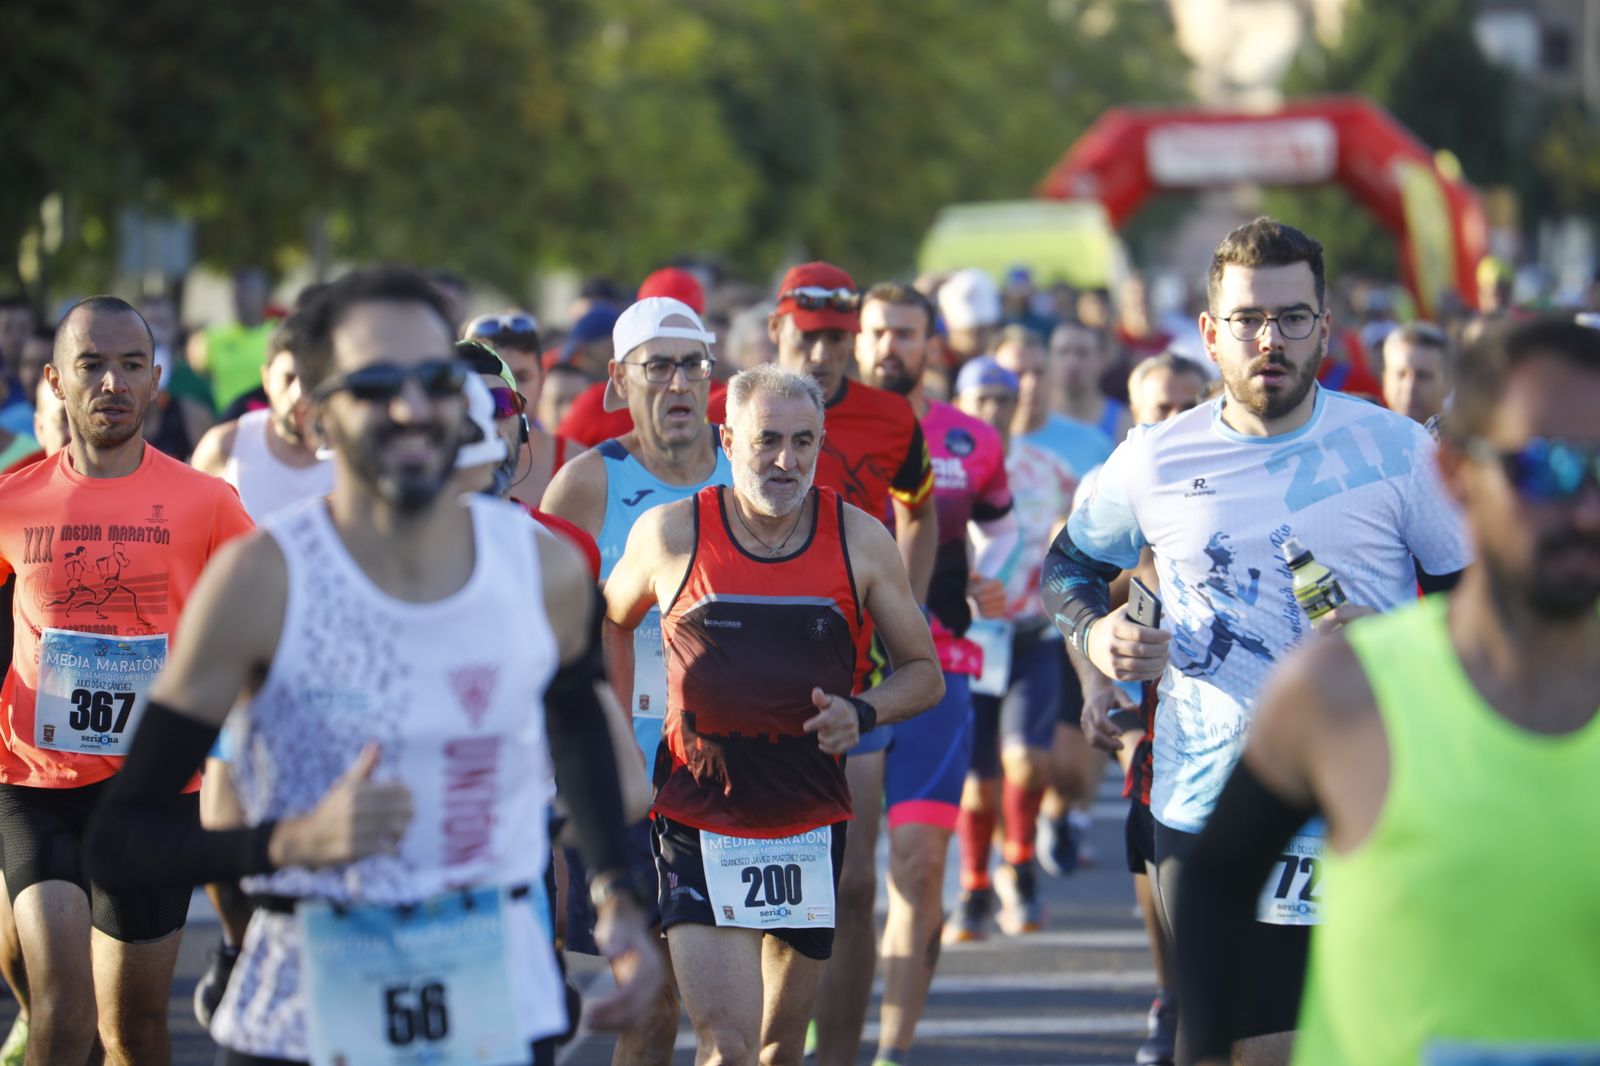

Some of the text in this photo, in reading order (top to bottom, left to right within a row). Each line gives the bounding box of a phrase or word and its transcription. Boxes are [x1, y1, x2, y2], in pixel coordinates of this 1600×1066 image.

[24, 524, 170, 564] XXX MEDIA MARATÓN
[46, 653, 163, 673] MEDIA MARATÓN
[69, 688, 136, 733] 367
[709, 837, 756, 849] MEDIA
[751, 855, 770, 865] JAVIER
[741, 864, 803, 908] 200
[1273, 855, 1323, 904] 72
